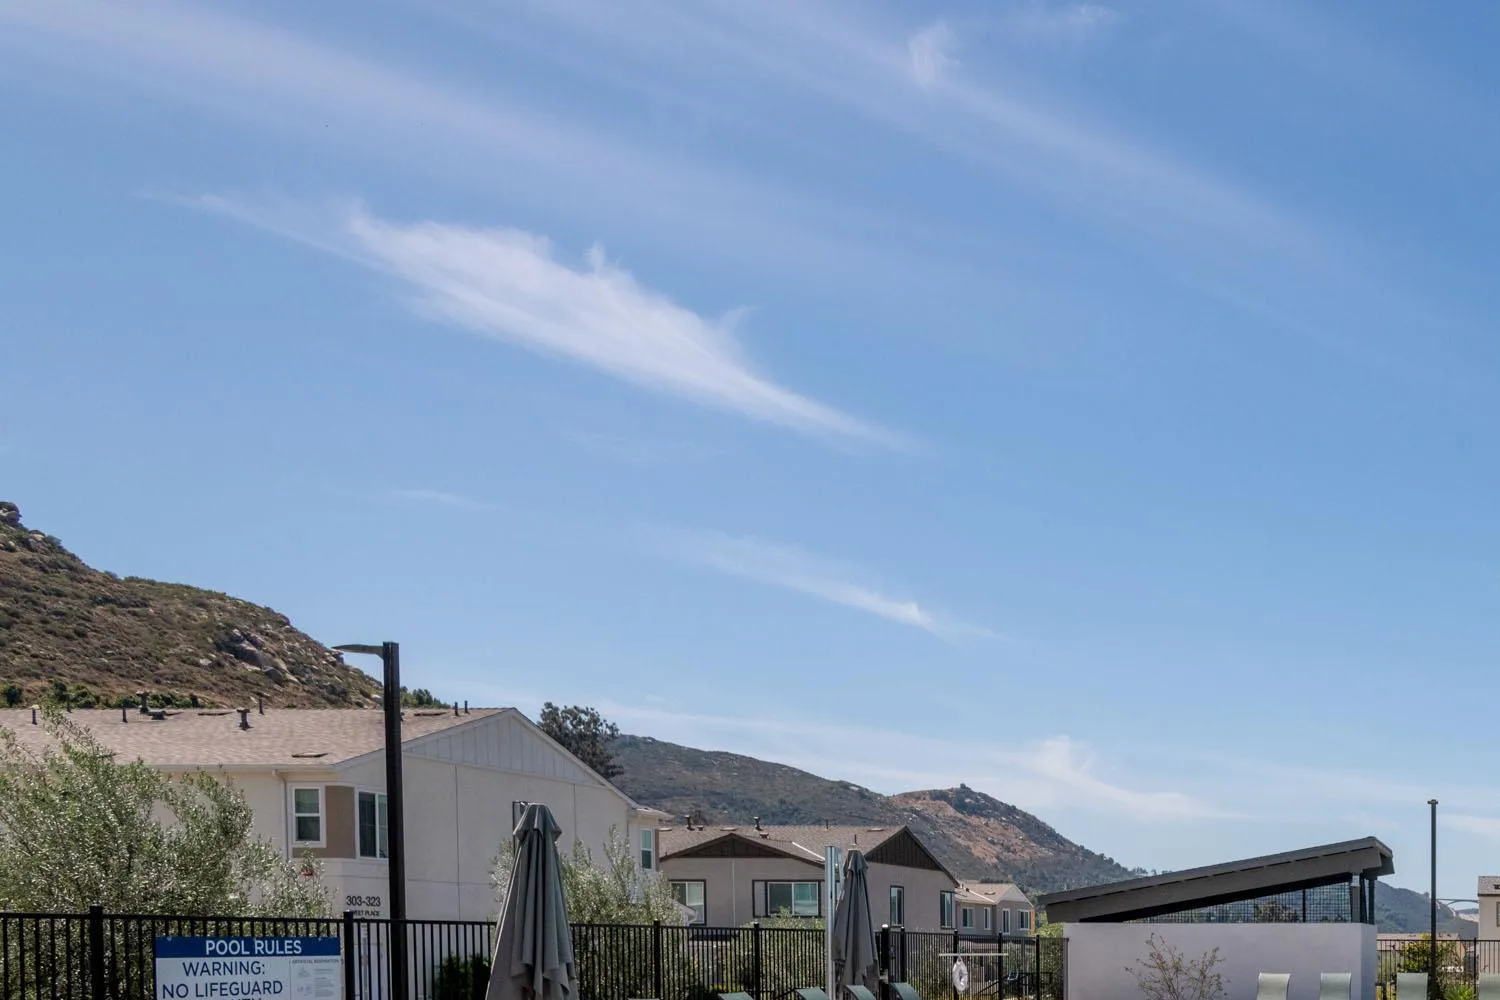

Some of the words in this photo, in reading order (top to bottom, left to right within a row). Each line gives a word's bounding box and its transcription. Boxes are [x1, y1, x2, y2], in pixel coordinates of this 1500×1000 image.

[346, 895, 381, 907] 303-323
[205, 940, 250, 955] POOL
[254, 940, 302, 954] RULES
[182, 961, 266, 976] WARNING:
[162, 983, 189, 999] NO
[195, 980, 283, 998] LIFEGUARD
